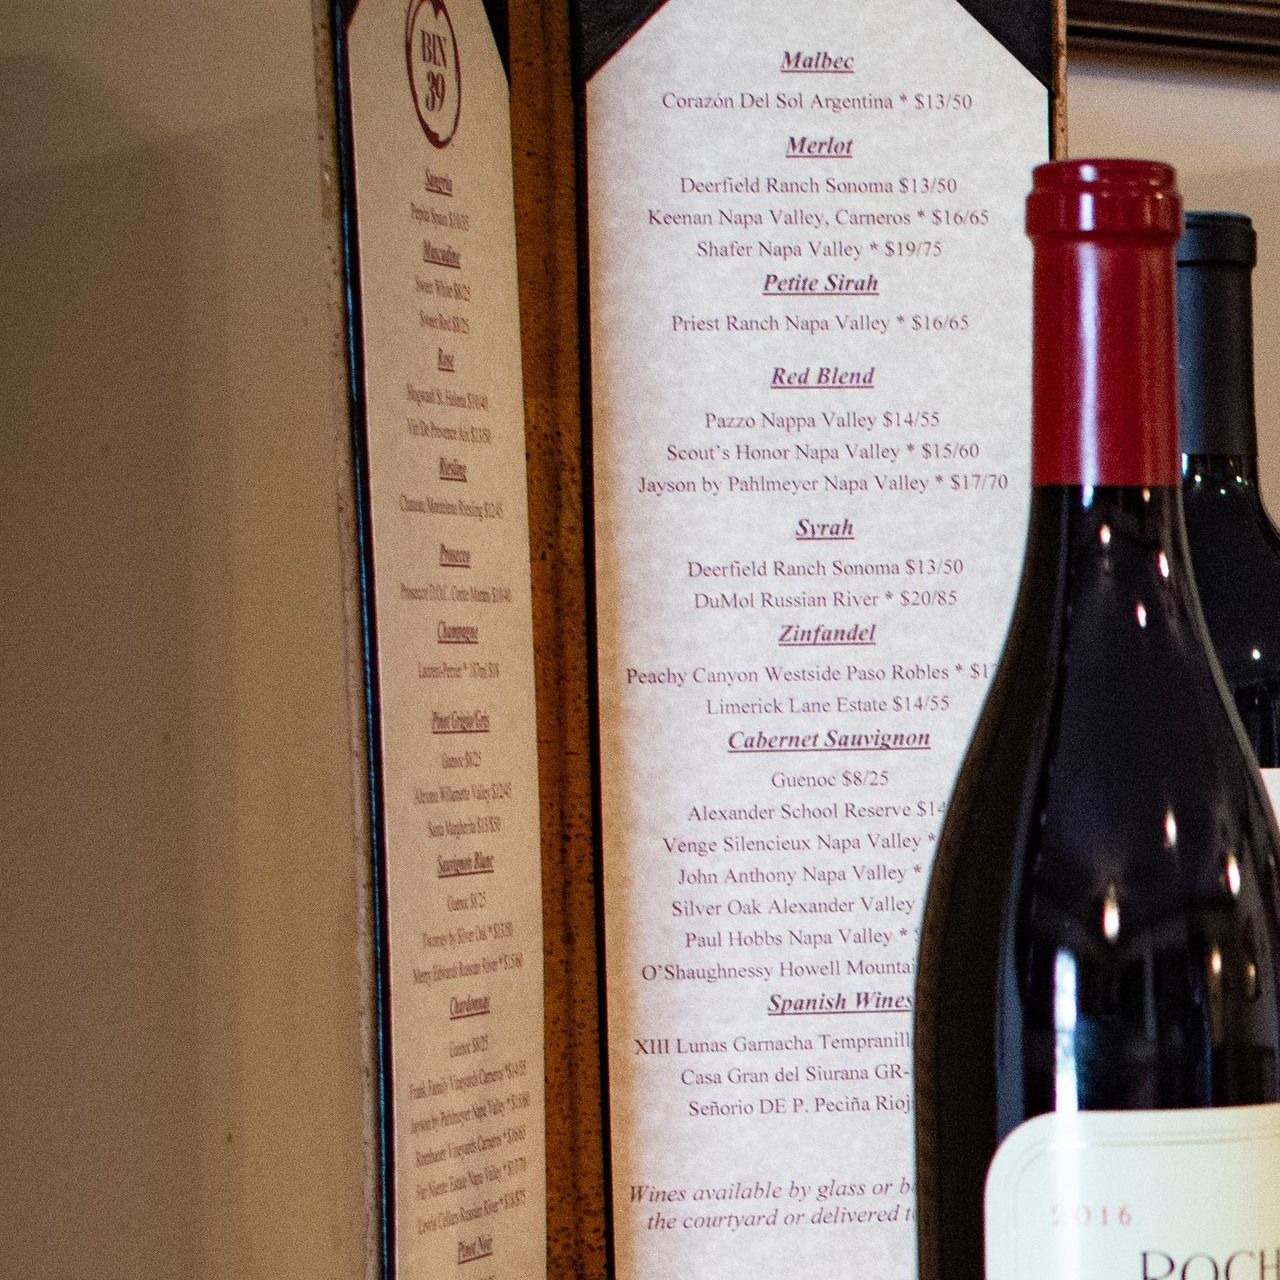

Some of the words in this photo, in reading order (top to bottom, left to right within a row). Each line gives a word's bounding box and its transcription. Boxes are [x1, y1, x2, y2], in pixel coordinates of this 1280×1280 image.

[420, 30, 447, 69] BIN
[779, 51, 855, 71] Malbec
[425, 70, 446, 112] 39
[739, 93, 770, 109] Del
[775, 93, 804, 109] Sol
[809, 93, 894, 113] Argentina
[914, 93, 973, 110] $13/50
[785, 136, 854, 154] Merlot
[679, 177, 761, 193] Deerfield
[765, 177, 820, 193] Ranch
[824, 178, 894, 193] Sonoma
[898, 177, 958, 194] $13/50
[647, 209, 713, 225] Keenan
[717, 209, 764, 229] Napa
[768, 209, 830, 229] Valley,
[834, 209, 912, 225] Carneros
[931, 209, 990, 225] $16/65
[696, 241, 754, 257] Shafer
[757, 241, 803, 261] Napa
[807, 241, 863, 261] Valley
[884, 241, 943, 257] $19/75
[762, 274, 820, 292] Petite
[823, 273, 879, 292] Sirah
[769, 367, 811, 387] Red
[815, 366, 877, 386] Blend
[735, 444, 791, 460] Honor
[794, 444, 840, 463] Napa
[844, 443, 901, 463] Valley
[921, 443, 980, 459] $15/60
[637, 477, 697, 496] Jayson
[701, 476, 720, 495] by
[727, 476, 819, 495] Pahlmeyer
[823, 475, 869, 494] Napa
[873, 475, 929, 494] Valley
[949, 474, 1009, 491] $17/70
[794, 518, 854, 536] Syrah
[687, 560, 768, 577] Deerfield
[772, 560, 827, 576] Ranch
[831, 559, 900, 577] Sonoma
[905, 558, 966, 576] $13/50
[694, 593, 755, 609] DuMol
[760, 592, 827, 608] Russian
[832, 591, 880, 607] River
[899, 590, 958, 607] $20/85
[777, 624, 877, 643] Zinfandel
[625, 668, 688, 686] Peachy
[691, 667, 759, 686] Canyon
[764, 665, 842, 682] Westside
[846, 665, 887, 681] Paso
[891, 664, 950, 680] Robles
[727, 730, 820, 750] Cabernet
[824, 728, 932, 749] Sauvignon
[770, 772, 837, 788] Guenoc
[841, 770, 889, 787] $8/25
[687, 804, 776, 821] Alexander
[780, 803, 838, 819] School
[844, 803, 912, 818] Reserve
[662, 838, 718, 856] Venge
[722, 835, 812, 852] Silencieux
[816, 834, 862, 853] Napa
[866, 833, 922, 852] Valley
[677, 869, 719, 885] John
[723, 868, 797, 886] Anthony
[801, 867, 847, 886] Napa
[851, 866, 907, 884] Valley
[671, 900, 723, 916] Silver
[726, 899, 762, 915] Oak
[767, 897, 856, 914] Alexander
[859, 896, 915, 915] Valley
[779, 962, 841, 977] Howell
[767, 992, 847, 1013] Spanish
[854, 991, 913, 1010] Wines
[634, 1039, 670, 1055] XIII
[675, 1038, 728, 1054] Lunas
[732, 1035, 814, 1052] Garnacha
[680, 1069, 723, 1085] Casa
[726, 1068, 769, 1083] Gran
[774, 1066, 800, 1082] del
[805, 1066, 870, 1081] Siurana
[688, 1100, 755, 1116] Señorio
[814, 1096, 871, 1112] Peciña
[692, 1181, 783, 1201] available
[788, 1181, 812, 1200] by
[815, 1179, 867, 1200] glass
[871, 1183, 894, 1195] or
[647, 1212, 678, 1230] the
[682, 1208, 779, 1232] courtyard
[782, 1213, 806, 1225] or
[809, 1205, 901, 1224] delivered
